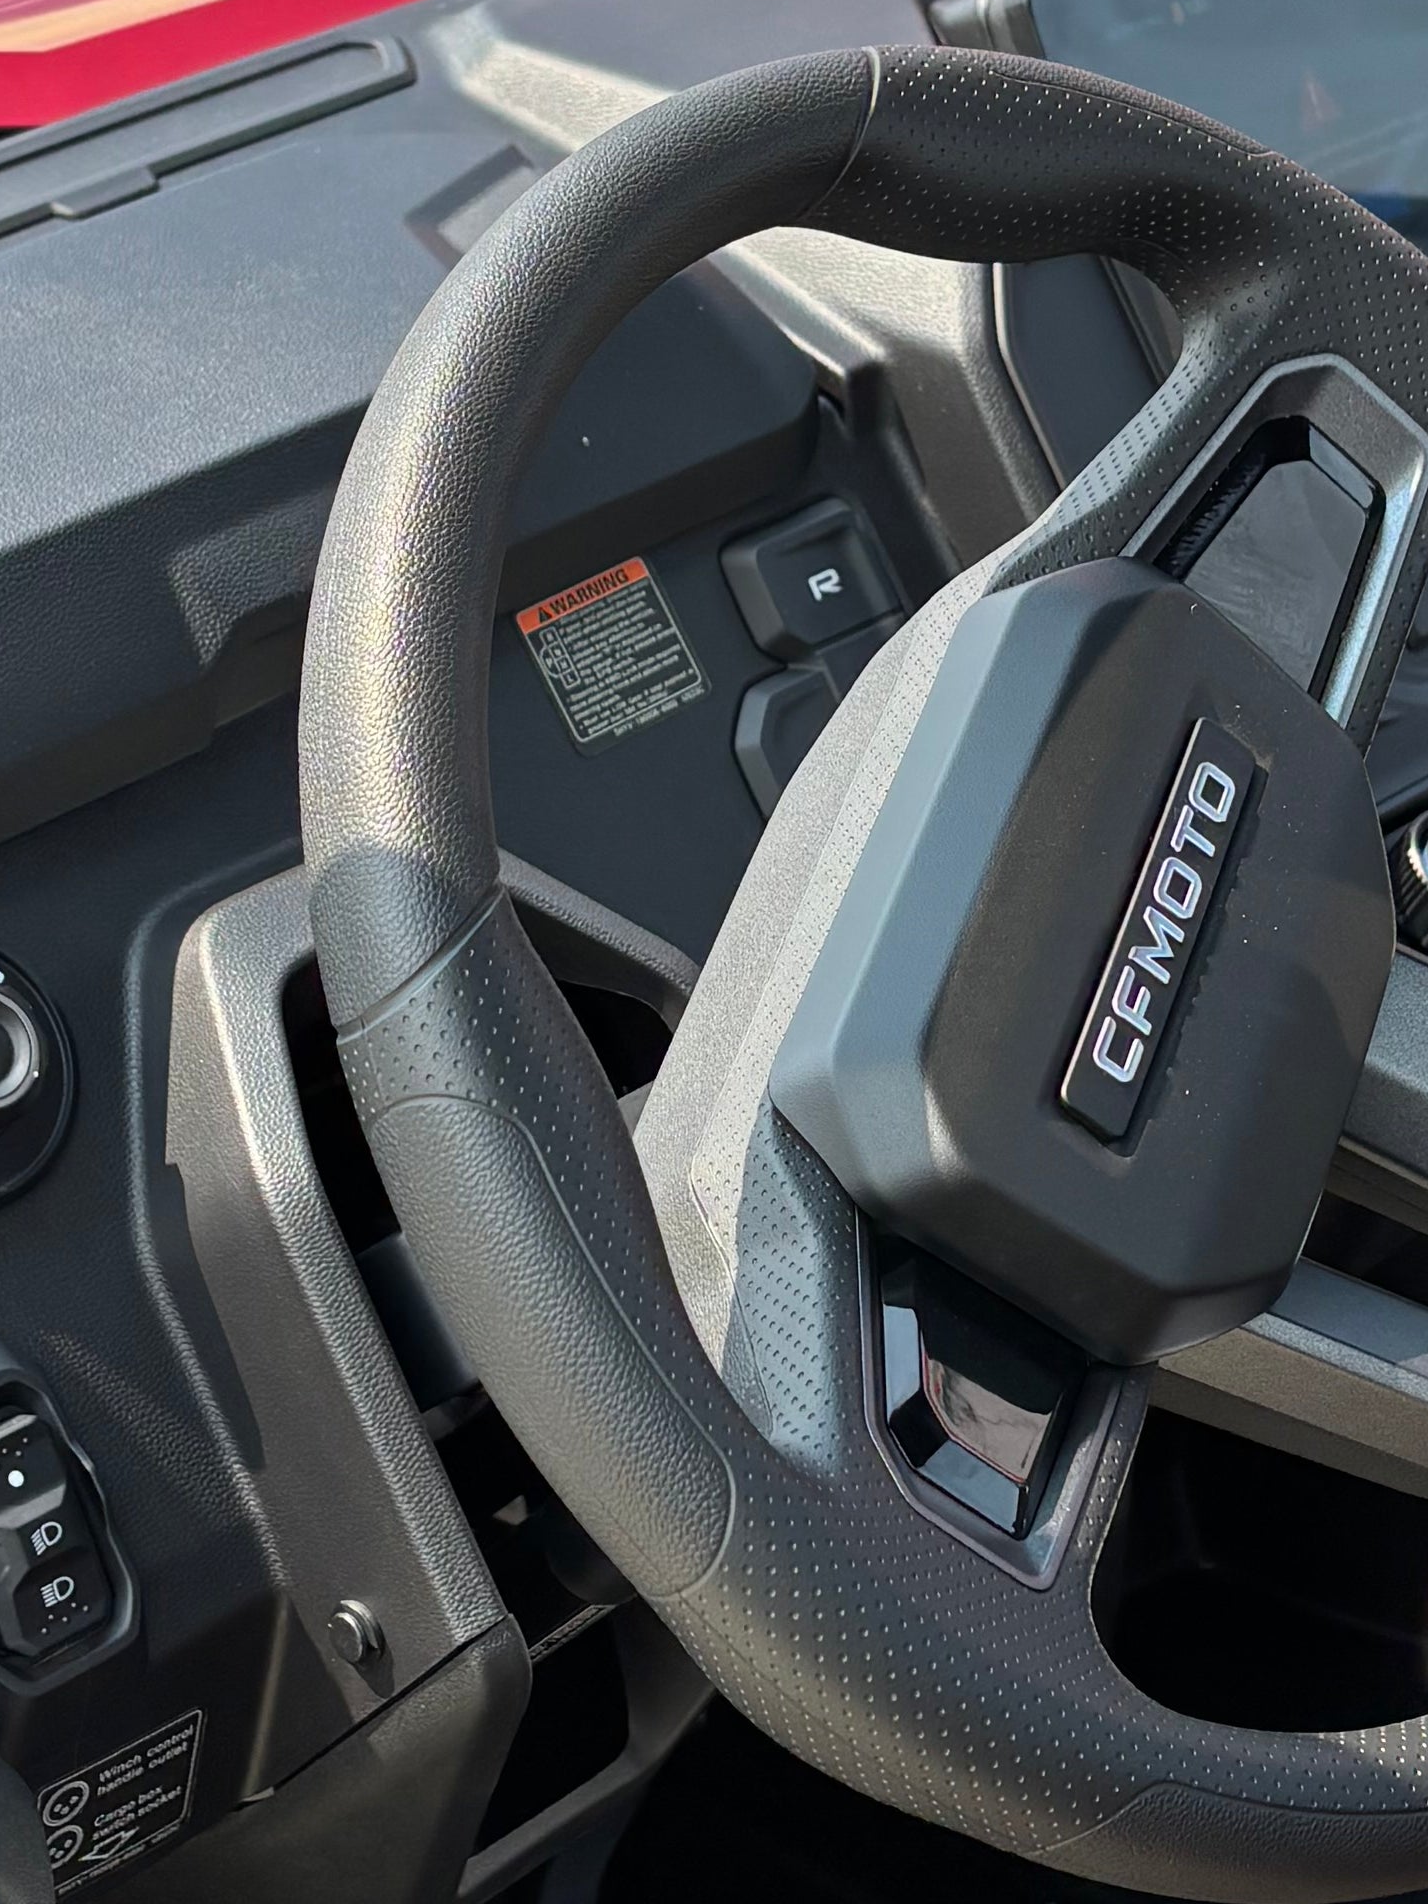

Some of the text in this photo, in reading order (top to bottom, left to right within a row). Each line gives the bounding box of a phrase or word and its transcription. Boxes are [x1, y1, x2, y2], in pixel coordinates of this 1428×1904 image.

[550, 569, 628, 615] WARNING
[1093, 762, 1236, 1082] CFMOTO
[97, 1741, 188, 1796] handle outlet
[99, 1724, 193, 1783] Winch control
[92, 1785, 182, 1841] switch socket
[94, 1786, 162, 1827] Cargo box
